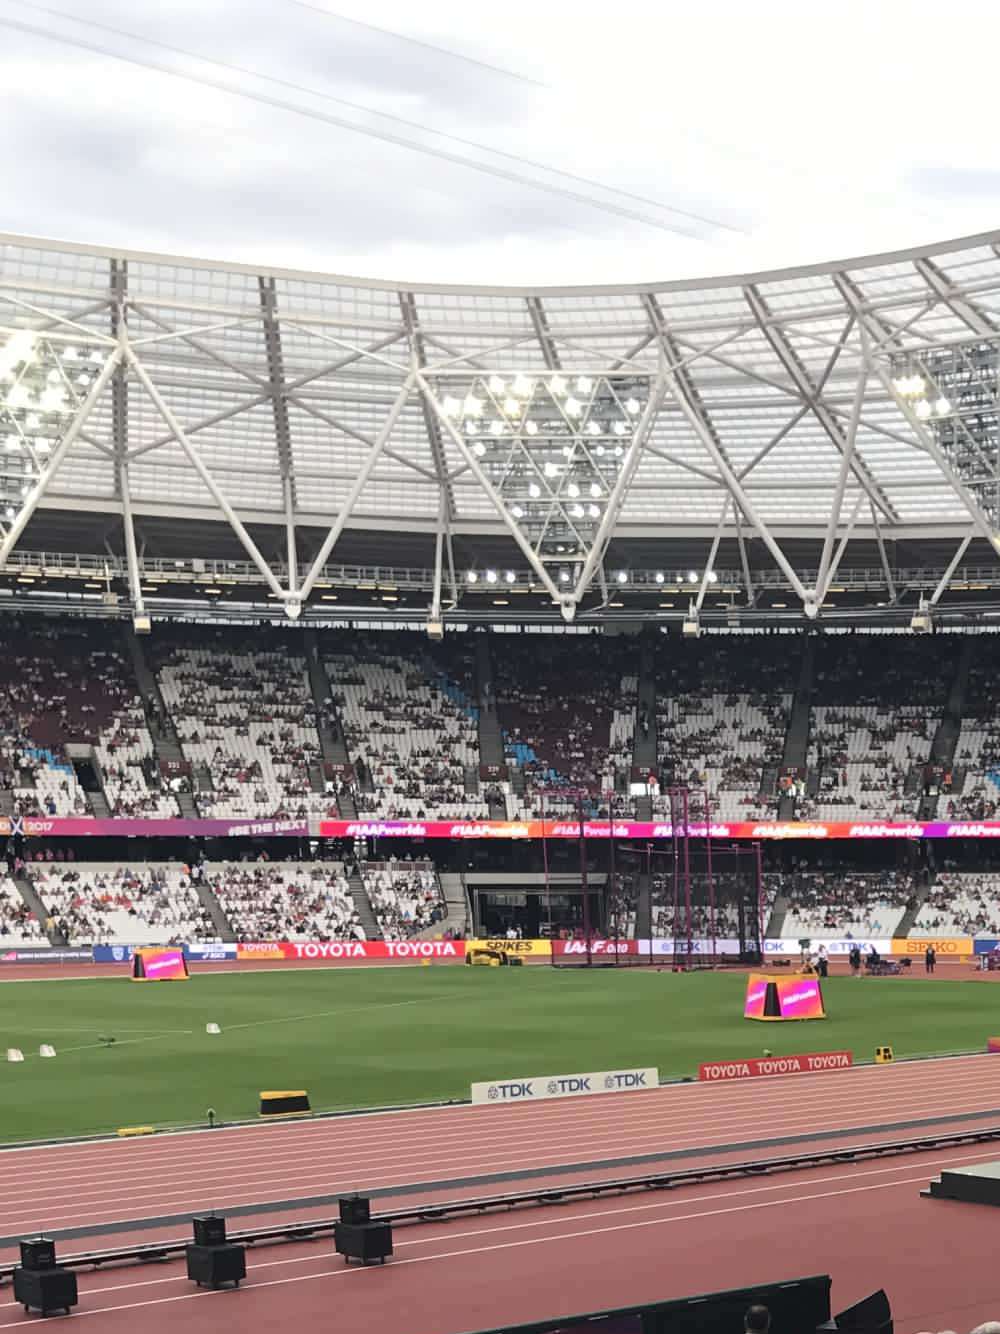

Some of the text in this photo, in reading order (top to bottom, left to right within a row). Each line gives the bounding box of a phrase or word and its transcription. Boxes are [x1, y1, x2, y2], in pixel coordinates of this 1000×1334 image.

[294, 943, 367, 957] TOYOTA
[385, 942, 456, 956] TOYOTA
[486, 941, 533, 951] SPIKES
[704, 1054, 849, 1079] TOYOTA TOYOTA TOYOTA
[557, 1077, 591, 1093] TDK
[613, 1072, 646, 1087] TDK
[499, 1083, 534, 1098] TDK
